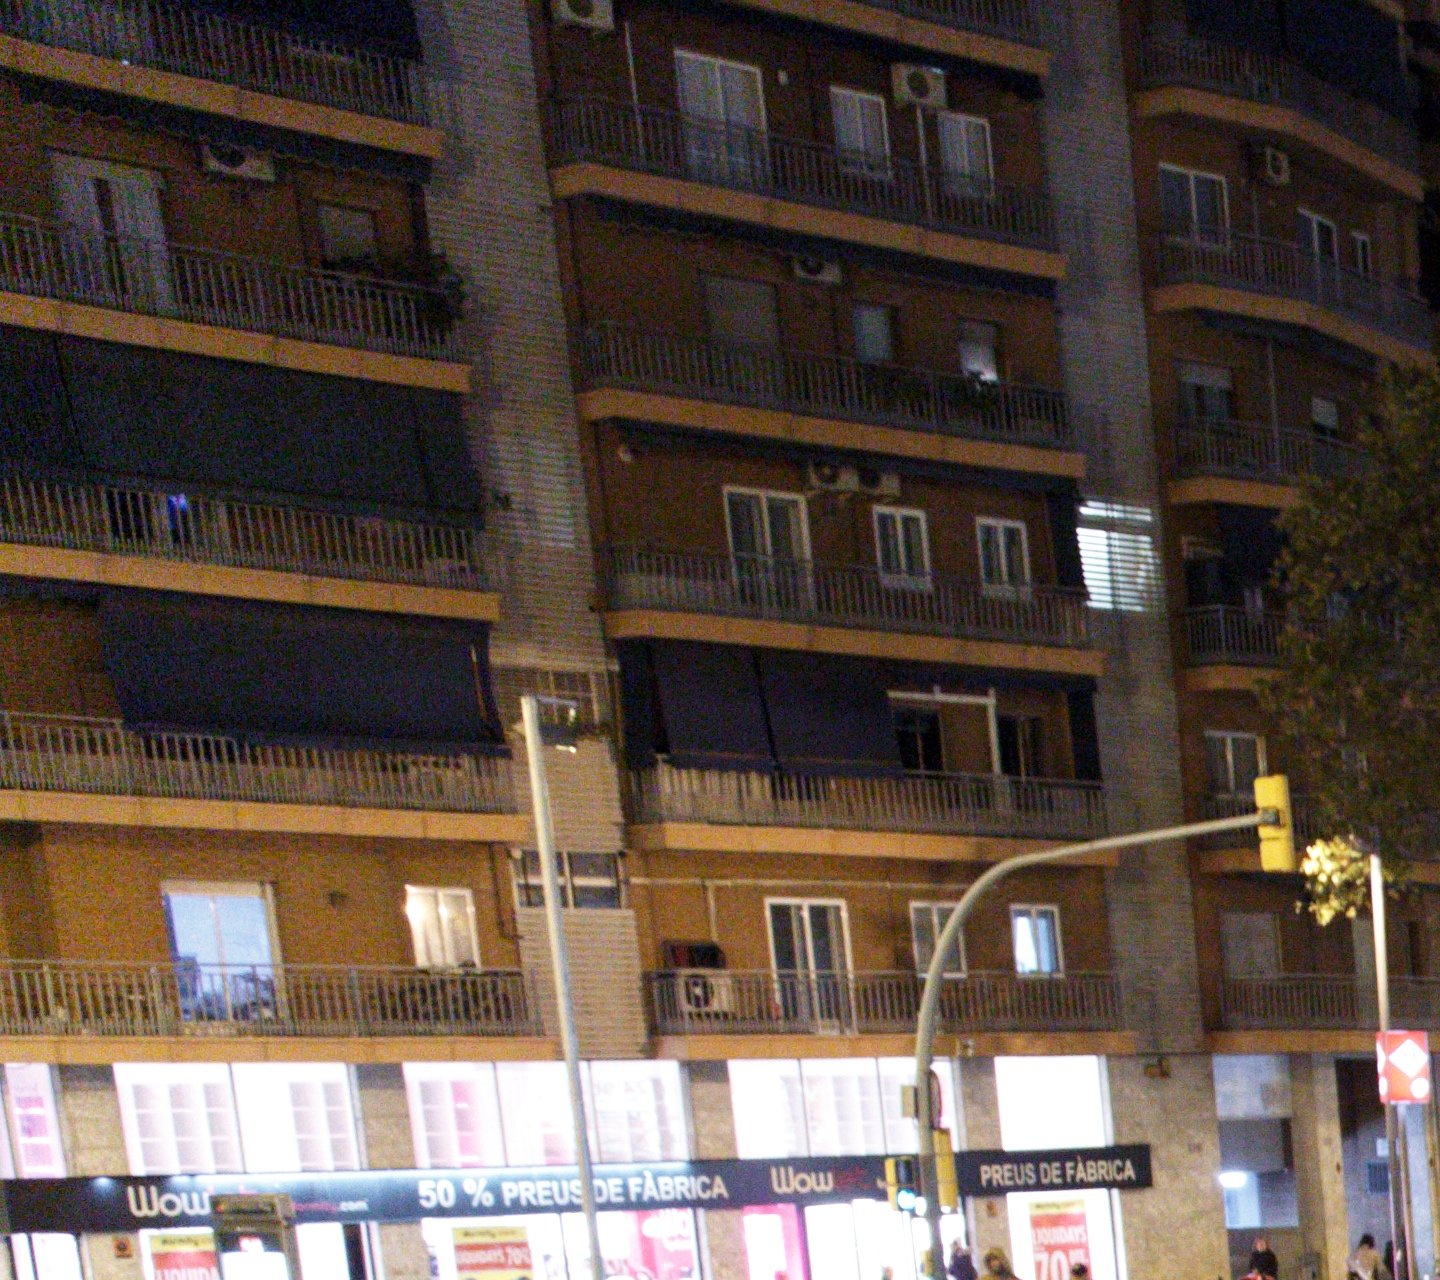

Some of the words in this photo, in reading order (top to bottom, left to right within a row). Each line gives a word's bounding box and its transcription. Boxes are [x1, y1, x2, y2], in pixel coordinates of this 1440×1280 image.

[980, 1164, 1036, 1187] PREUS
[1040, 1162, 1063, 1185] DE
[1065, 1155, 1136, 1183] FÀBRICA
[417, 1178, 456, 1209] 50
[462, 1177, 495, 1208] %
[501, 1179, 583, 1206] PREUS
[592, 1178, 624, 1203] DE
[627, 1170, 729, 1202] FÀBRICA
